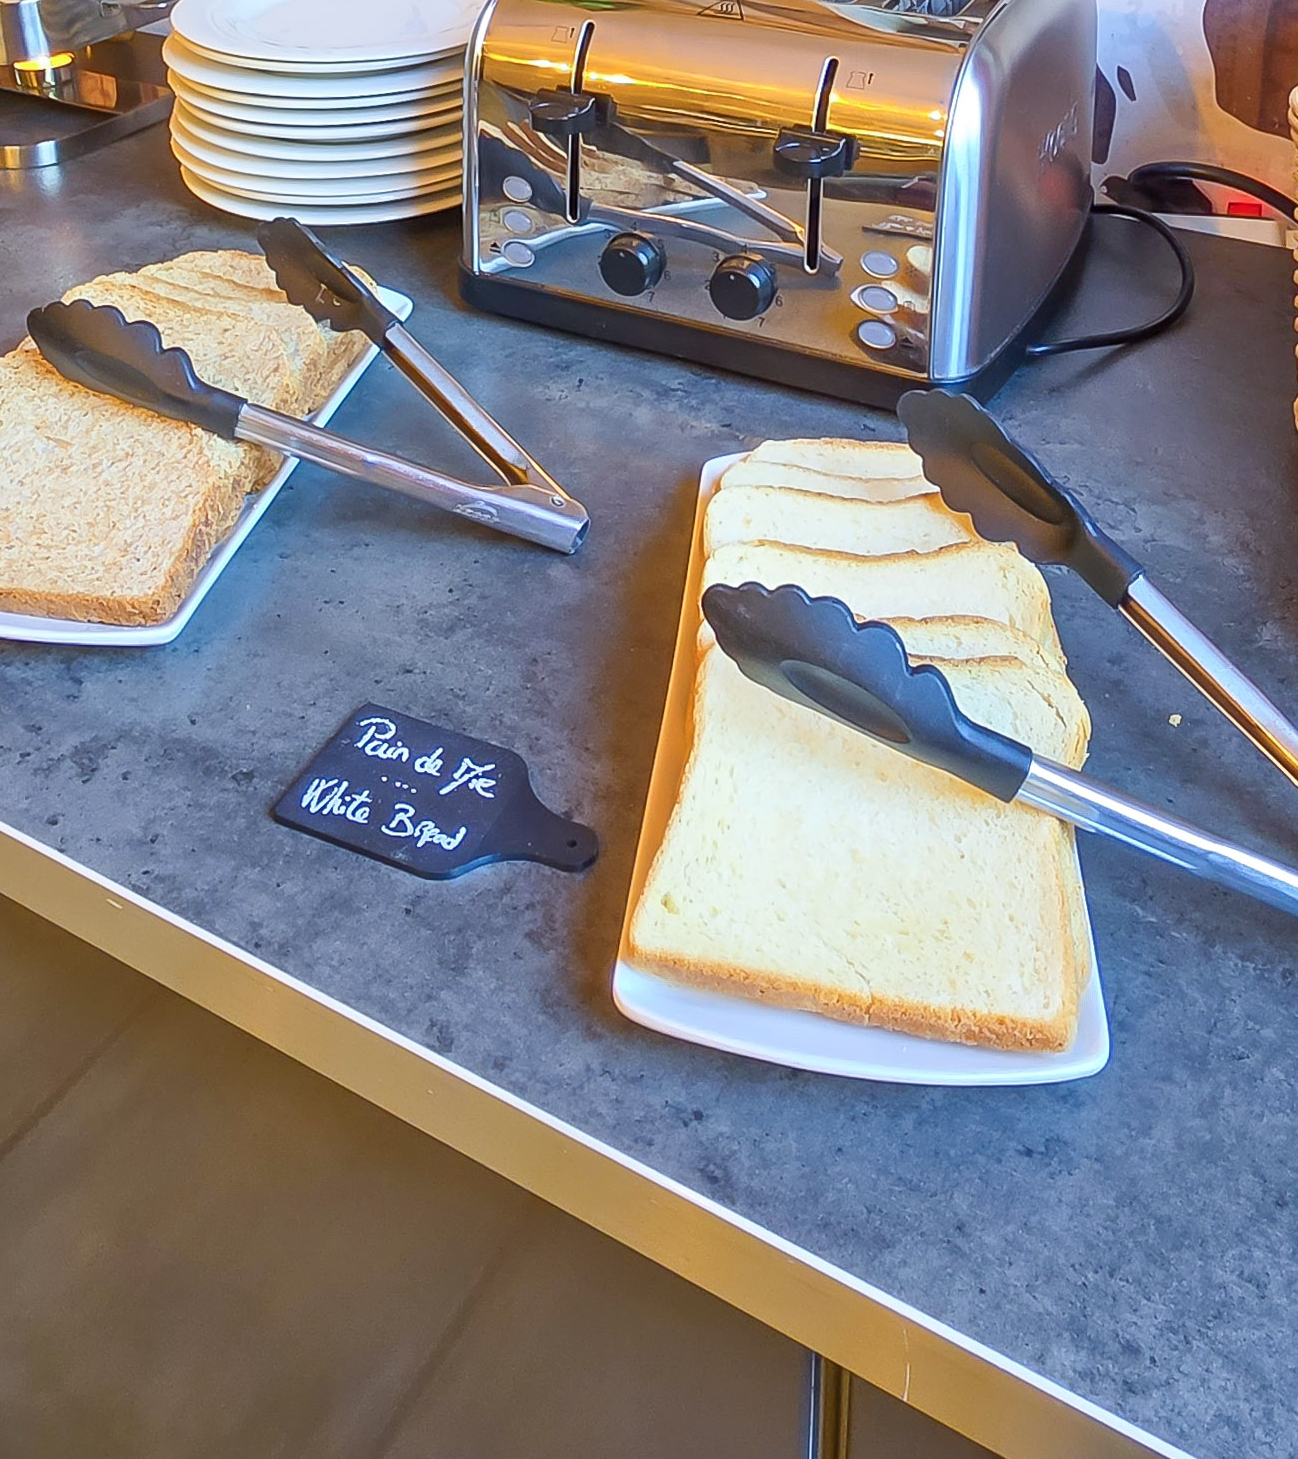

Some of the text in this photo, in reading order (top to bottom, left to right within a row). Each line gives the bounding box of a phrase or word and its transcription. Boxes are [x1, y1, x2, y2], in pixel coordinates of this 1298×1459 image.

[354, 716, 410, 764] Pain
[413, 746, 446, 777] de
[300, 777, 375, 824] White
